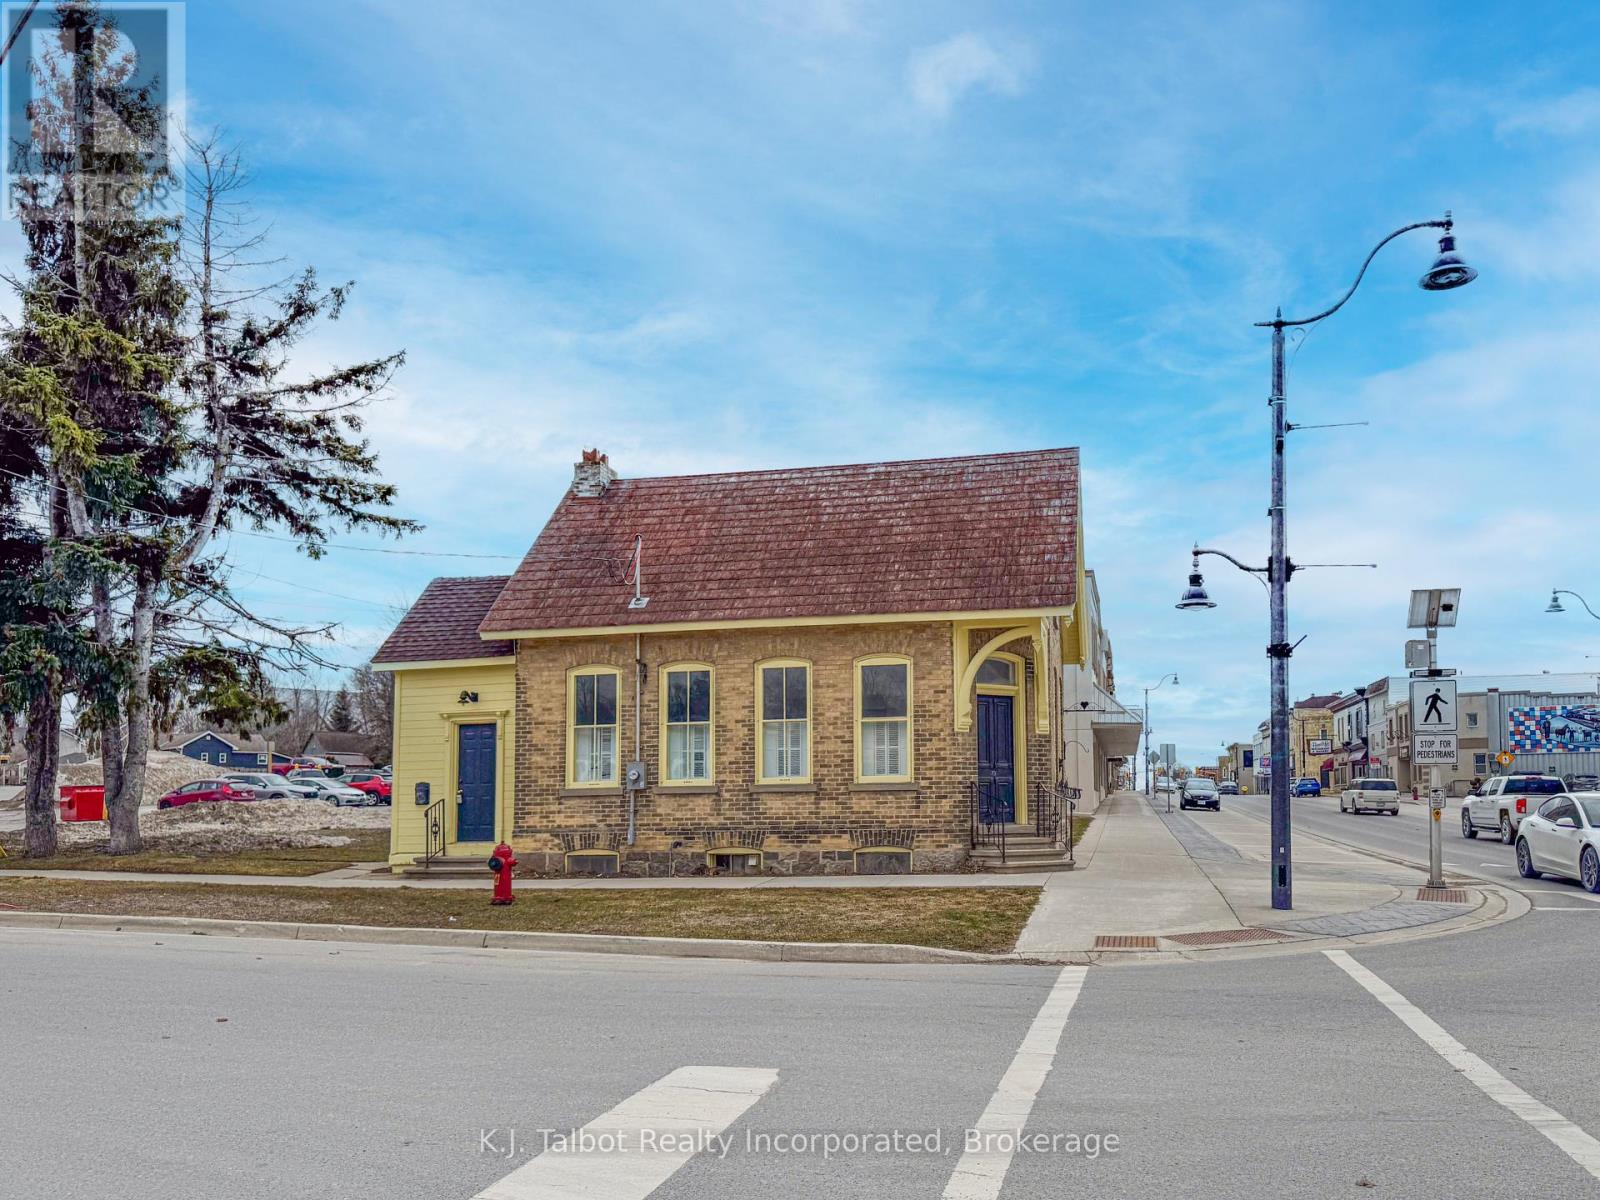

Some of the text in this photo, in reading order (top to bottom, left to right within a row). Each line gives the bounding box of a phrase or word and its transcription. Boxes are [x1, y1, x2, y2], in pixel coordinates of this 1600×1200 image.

[1420, 740, 1452, 749] STOP FOR
[1416, 750, 1455, 759] PEDESTRIANS
